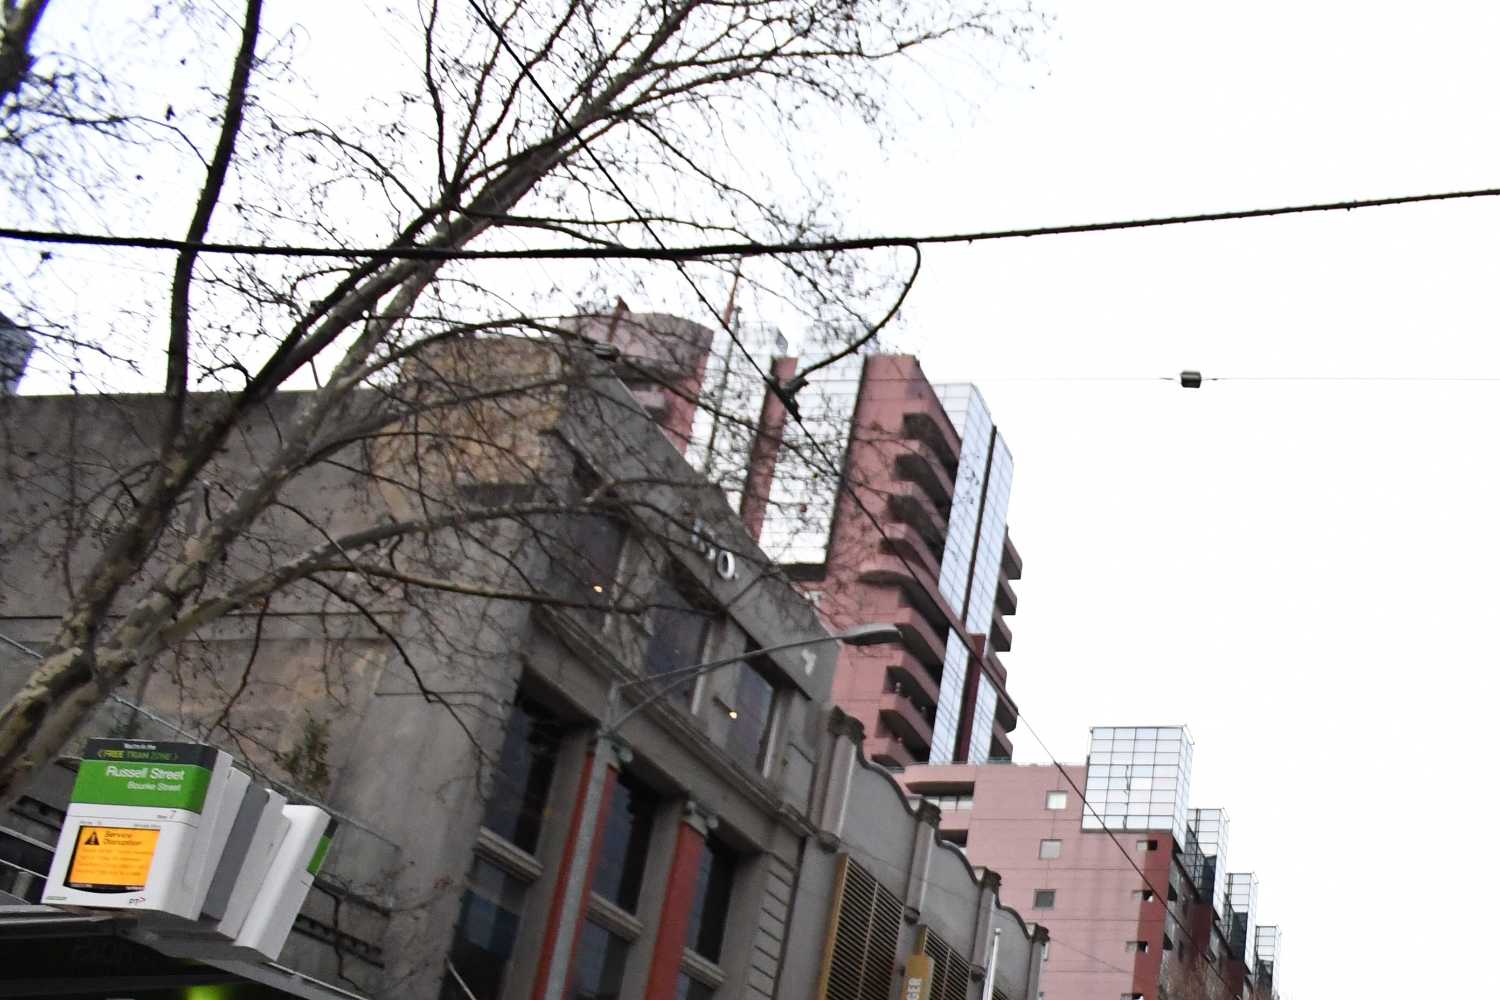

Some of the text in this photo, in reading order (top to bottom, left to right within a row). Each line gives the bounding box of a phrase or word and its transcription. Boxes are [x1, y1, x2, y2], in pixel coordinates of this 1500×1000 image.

[106, 766, 185, 780] Russell Street
[157, 783, 182, 791] Street
